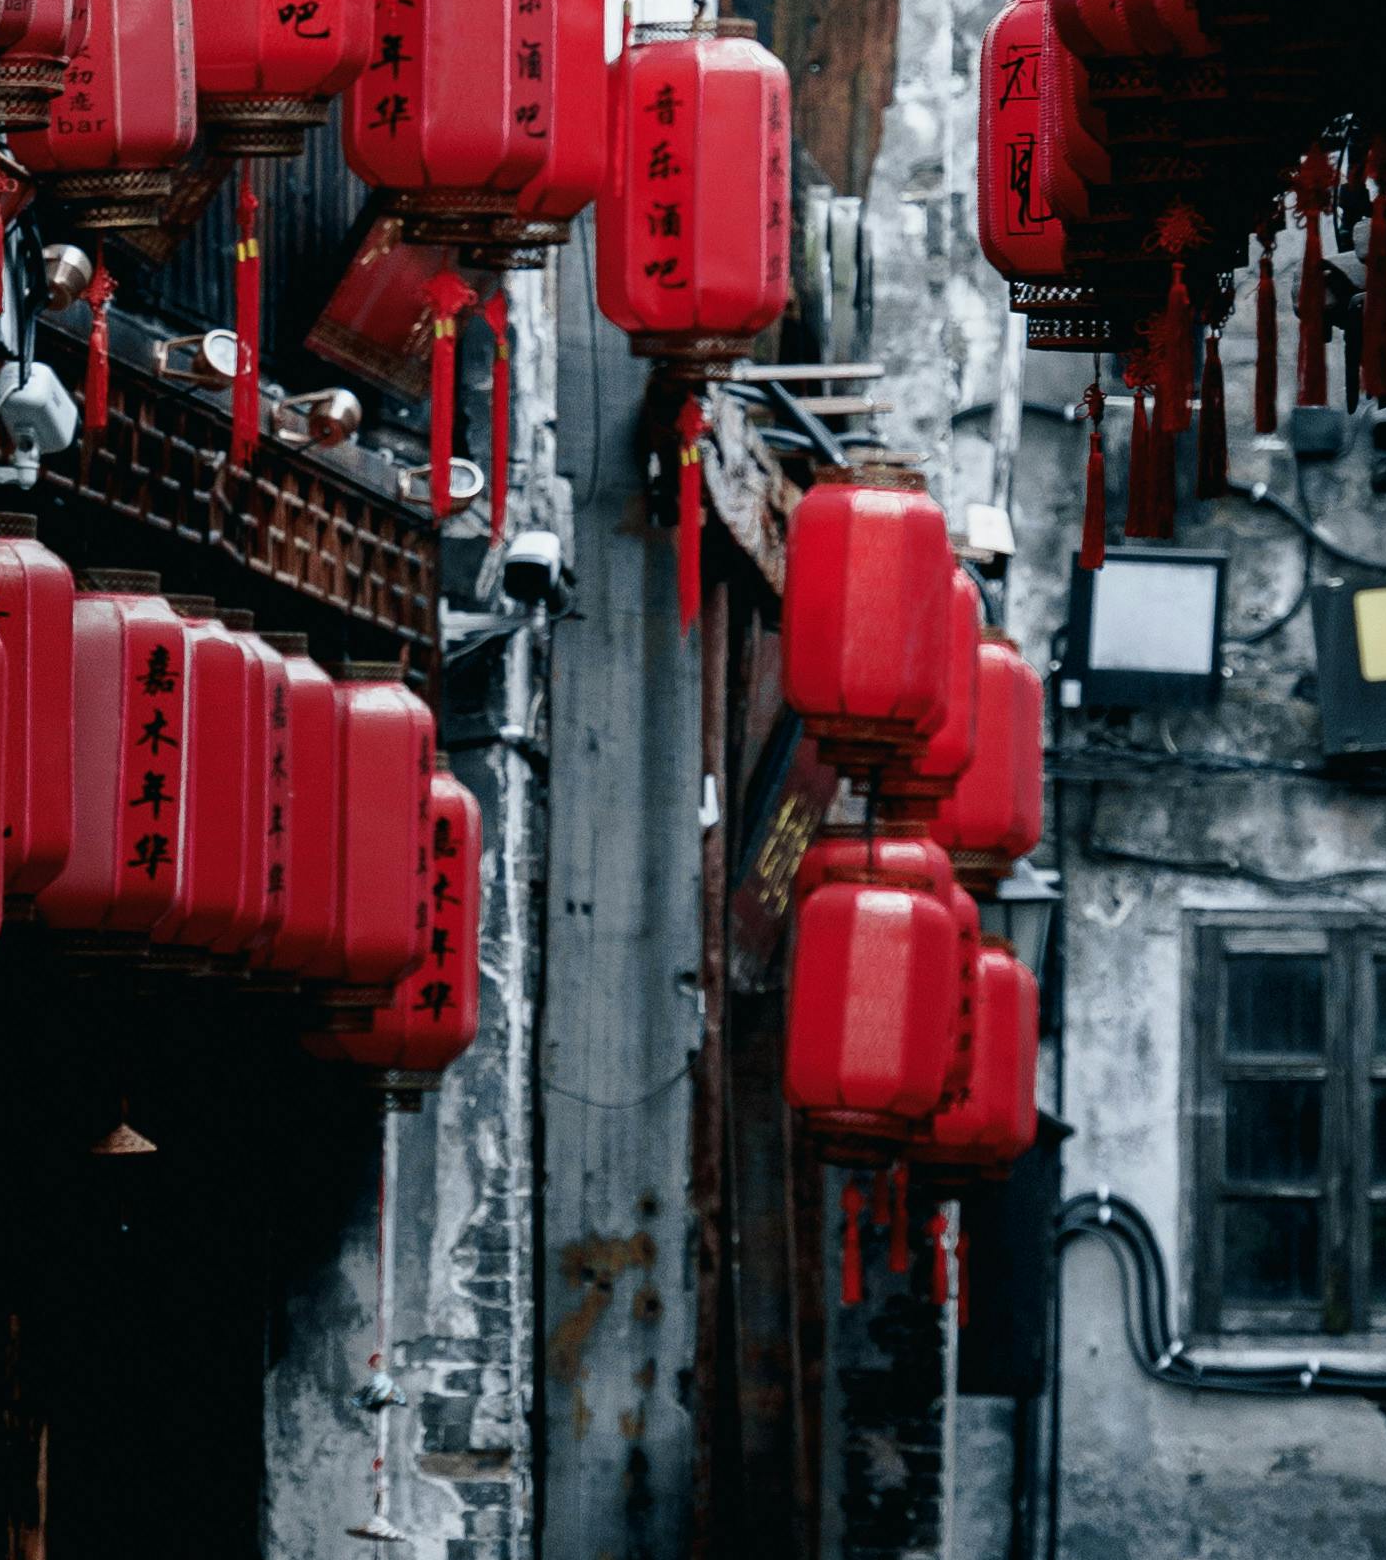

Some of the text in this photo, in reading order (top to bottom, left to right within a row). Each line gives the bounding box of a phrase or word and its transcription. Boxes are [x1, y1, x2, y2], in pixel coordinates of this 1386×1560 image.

[57, 115, 106, 135] bar
[645, 83, 688, 290] 音乐酒吧
[127, 645, 180, 879] 嘉木年华
